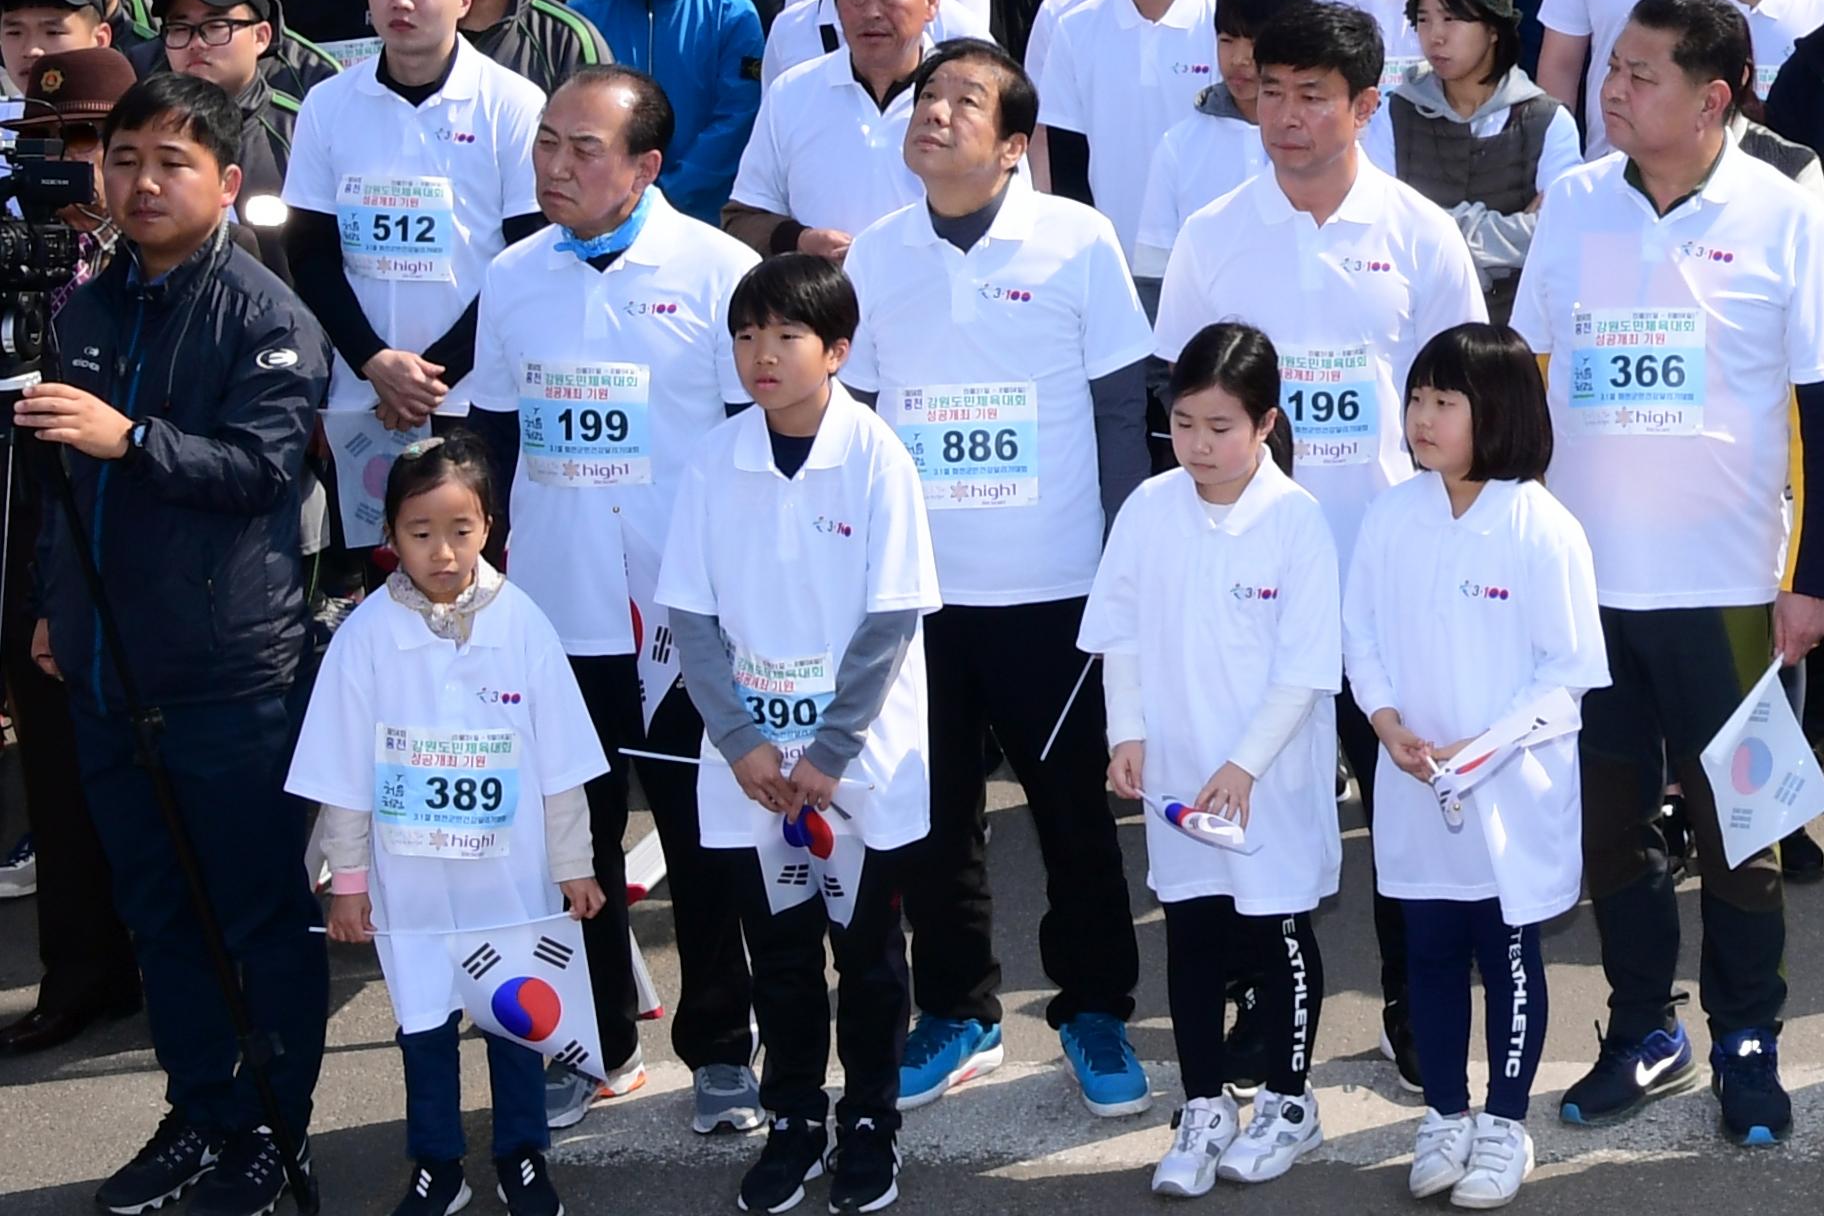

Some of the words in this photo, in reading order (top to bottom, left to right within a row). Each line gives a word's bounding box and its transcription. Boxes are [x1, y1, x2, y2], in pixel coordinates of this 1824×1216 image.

[400, 197, 419, 208] 기원
[372, 213, 436, 243] 512
[1643, 333, 1666, 345] 기원
[1608, 354, 1686, 389] 366
[586, 387, 609, 401] 기원
[1287, 389, 1360, 423] 196
[557, 408, 629, 443] 199
[975, 407, 998, 421] 기원
[942, 428, 1019, 464] 886
[746, 696, 817, 729] 390
[463, 755, 486, 769] 기원
[425, 776, 503, 812] 389
